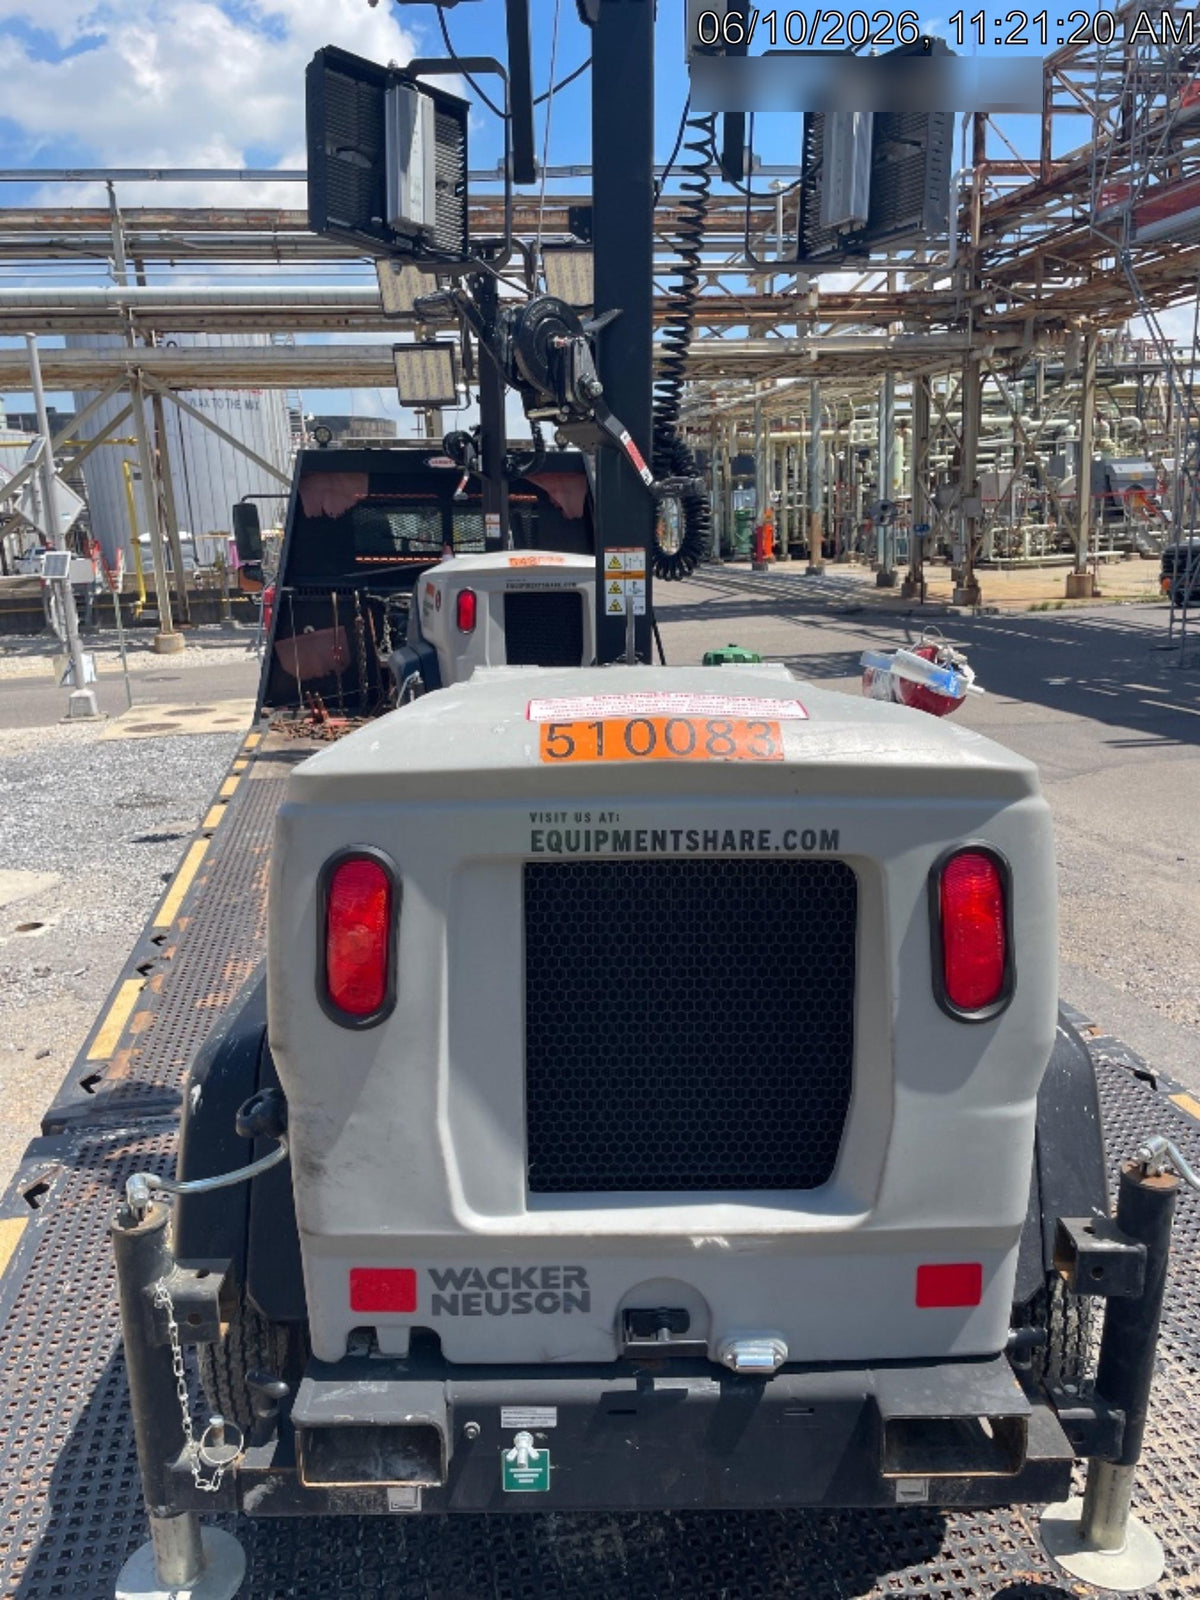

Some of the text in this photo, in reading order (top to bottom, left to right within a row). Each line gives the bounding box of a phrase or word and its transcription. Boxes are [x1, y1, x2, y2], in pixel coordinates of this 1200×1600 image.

[225, 398, 241, 410] THE
[545, 717, 776, 759] 510083
[529, 811, 620, 823] VISIT US AT:
[530, 829, 840, 853] EQUIPMENTSHARE.COM
[427, 1265, 590, 1291] WACKER
[431, 1291, 591, 1316] NEUSON
